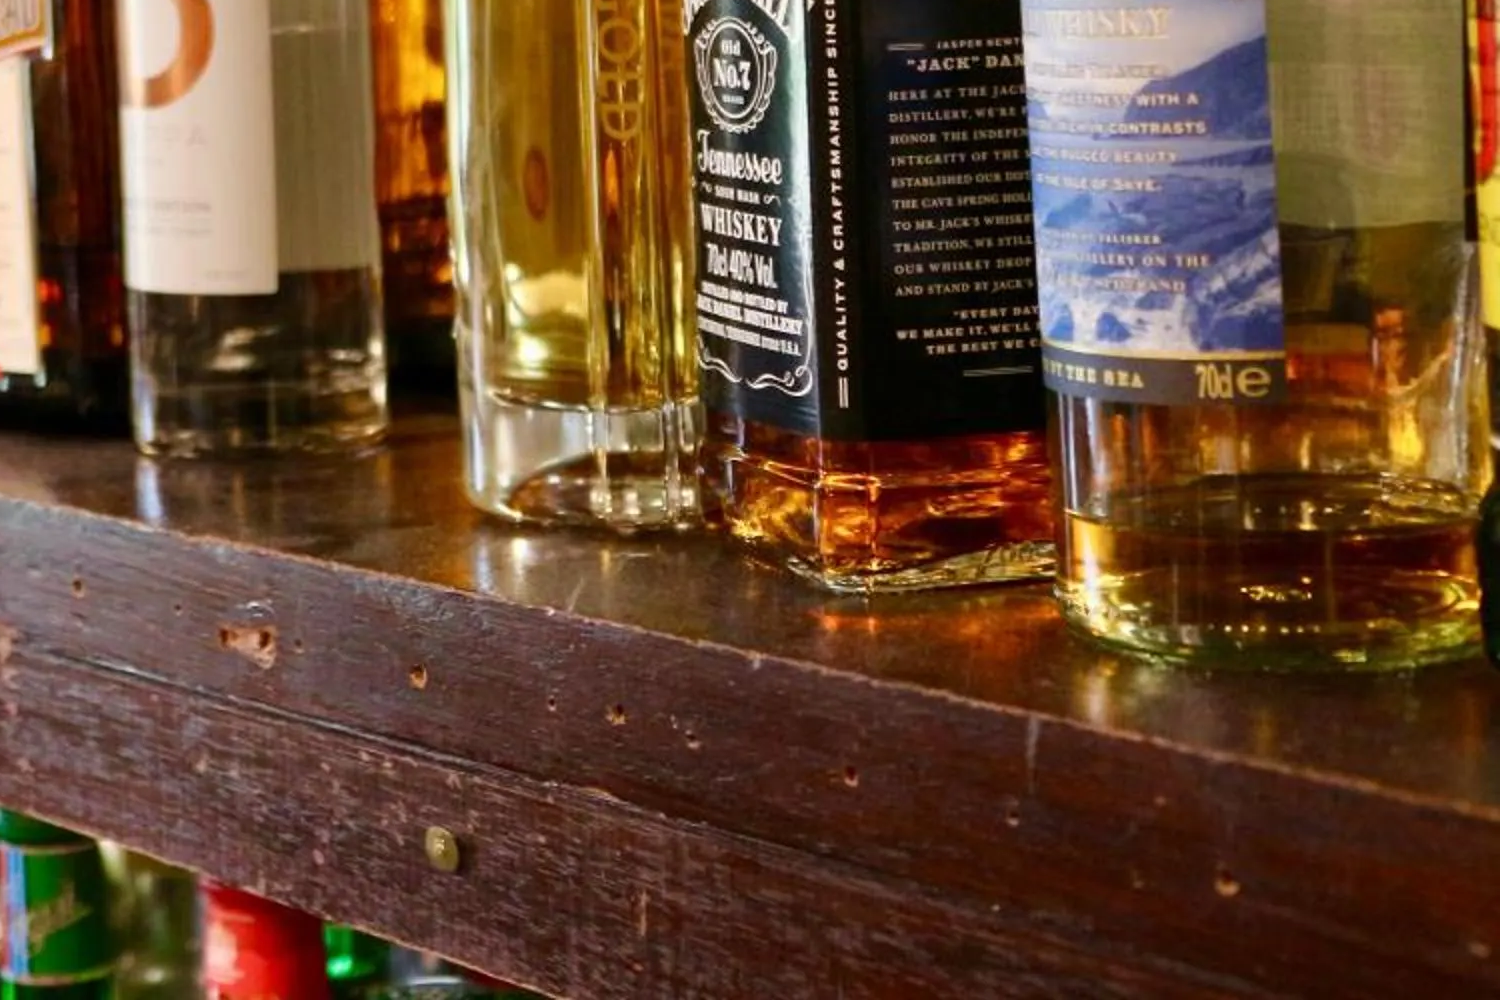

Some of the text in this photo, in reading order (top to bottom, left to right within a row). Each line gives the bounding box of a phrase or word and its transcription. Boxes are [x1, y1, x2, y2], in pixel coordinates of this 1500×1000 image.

[713, 58, 751, 90] No.7
[934, 88, 952, 99] AT
[958, 86, 987, 98] THE
[1108, 121, 1207, 135] CONTRASTS
[890, 132, 937, 145] HONOR
[942, 131, 969, 142] THE
[696, 129, 783, 185] Tennessee
[828, 67, 845, 251] CRAFTSMANSHIP
[890, 153, 967, 167] INTEGRITY
[972, 151, 988, 162] OF
[994, 150, 1021, 161] THE
[976, 172, 1001, 183] OUR
[892, 199, 918, 210] THE
[922, 198, 953, 209] CAVE
[957, 195, 999, 206] SPRING
[701, 203, 783, 246] WHISKEY
[892, 220, 912, 231] TO
[974, 237, 993, 248] WE
[894, 264, 924, 275] OUR
[929, 259, 991, 274] WHISKEY
[1141, 255, 1167, 267] ON
[1174, 254, 1211, 268] THE
[895, 284, 923, 297] AND
[927, 281, 970, 295] STAND
[834, 279, 849, 371] QUALITY
[896, 329, 919, 340] WE
[923, 327, 964, 339] MAKE
[926, 344, 957, 356] THE
[961, 341, 999, 353] BEST
[1003, 339, 1025, 350] WE
[1103, 370, 1145, 389] SEA
